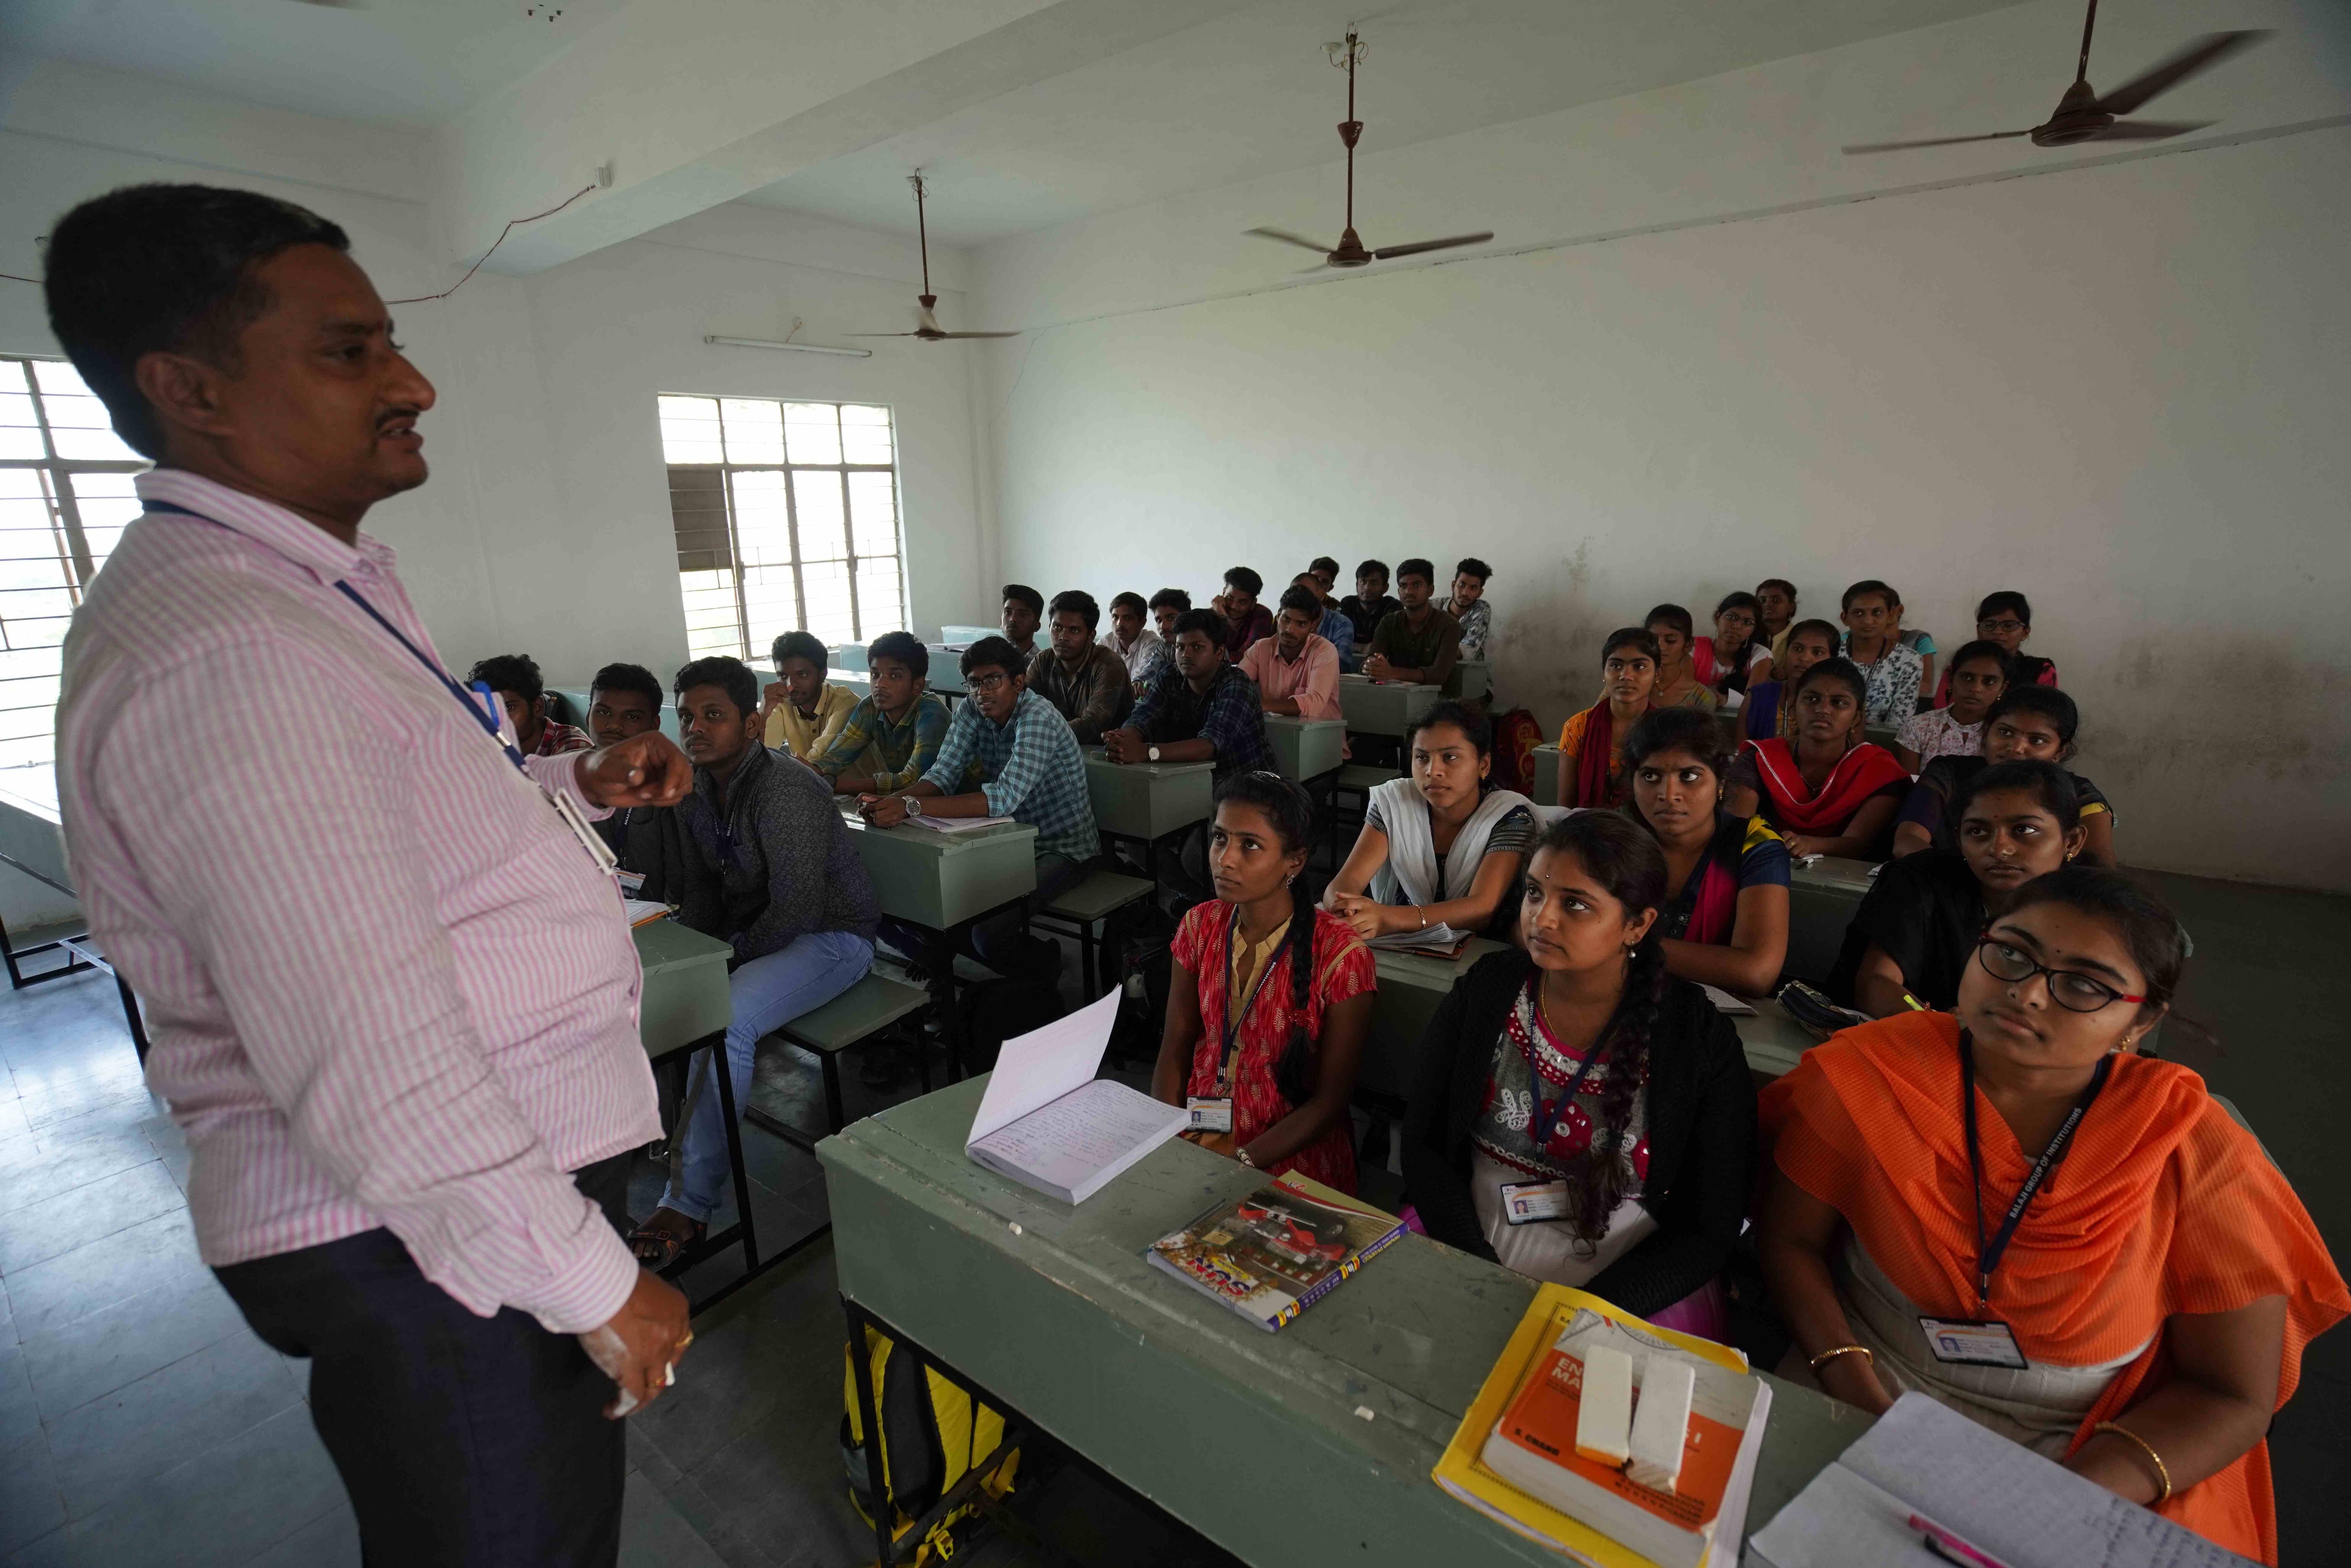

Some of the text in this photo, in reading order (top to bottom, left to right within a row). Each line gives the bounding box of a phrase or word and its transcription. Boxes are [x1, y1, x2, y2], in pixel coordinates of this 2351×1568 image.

[2009, 1107, 2082, 1219] BALAJI GROUP OF INSTITUTIONS
[1186, 1257, 1251, 1296] SUN
[1552, 1367, 1580, 1390] MA
[1558, 1357, 1583, 1377] EN
